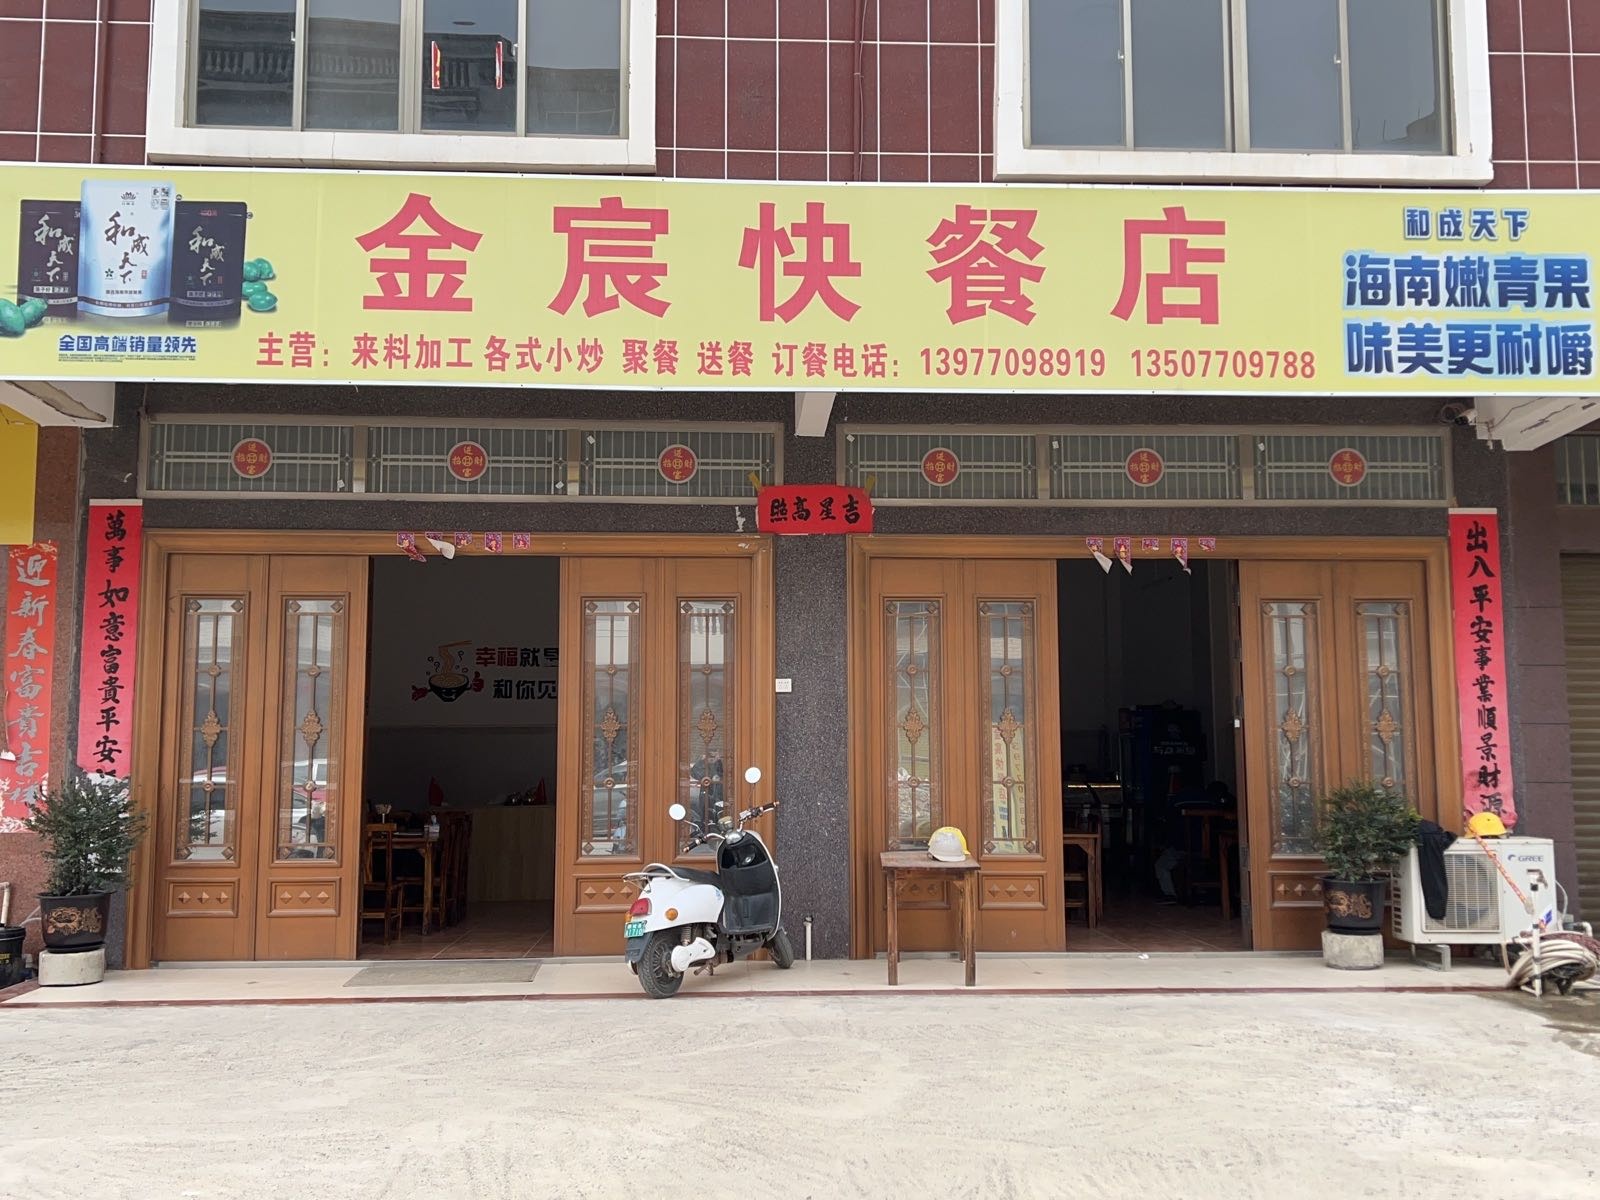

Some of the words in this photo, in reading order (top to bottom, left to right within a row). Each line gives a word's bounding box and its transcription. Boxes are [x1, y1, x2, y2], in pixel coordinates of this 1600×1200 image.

[1406, 208, 1528, 238] 和成天下
[356, 192, 1227, 326] 金宸快餐店
[1344, 253, 1592, 310] 海南嫩青果
[59, 334, 197, 354] 全国高端销量领先
[623, 338, 678, 375] 聚餐
[698, 341, 753, 377] 送餐
[920, 347, 1106, 377] 13977098919
[1132, 348, 1316, 379] 13507709788
[1345, 320, 1594, 376] 味美更耐嚼
[92, 509, 130, 779] 萬事如意富貴平安
